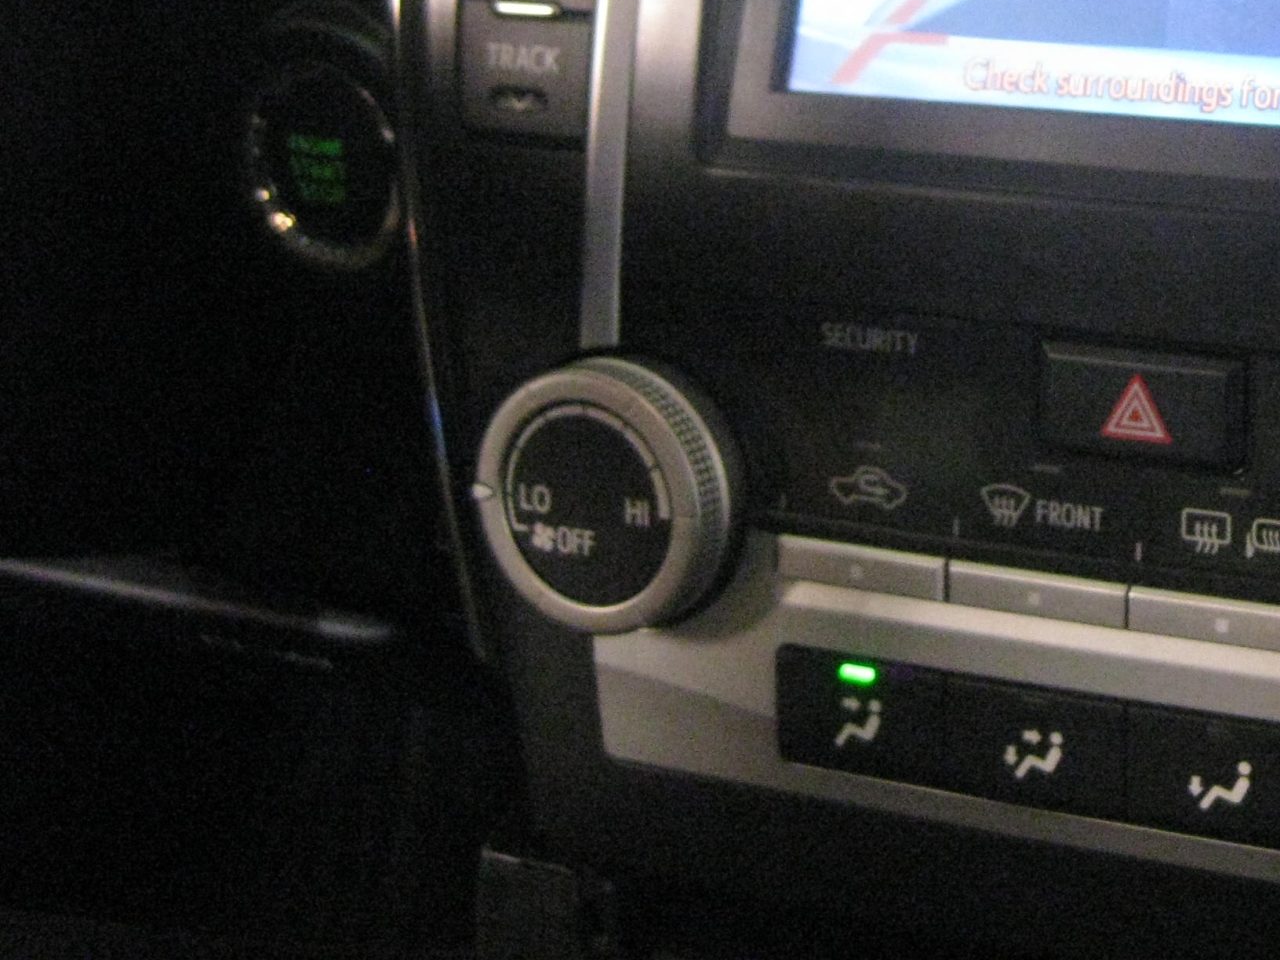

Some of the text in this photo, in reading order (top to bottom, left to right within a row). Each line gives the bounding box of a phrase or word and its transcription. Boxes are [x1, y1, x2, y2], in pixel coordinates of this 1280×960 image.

[488, 42, 562, 74] TRACK
[964, 56, 1048, 95] Check
[1056, 69, 1233, 114] surroundings
[820, 322, 918, 354] SECURITY
[518, 483, 553, 516] LO
[624, 498, 650, 529] HI
[1034, 499, 1104, 532] FRONT
[554, 528, 596, 557] OFF
